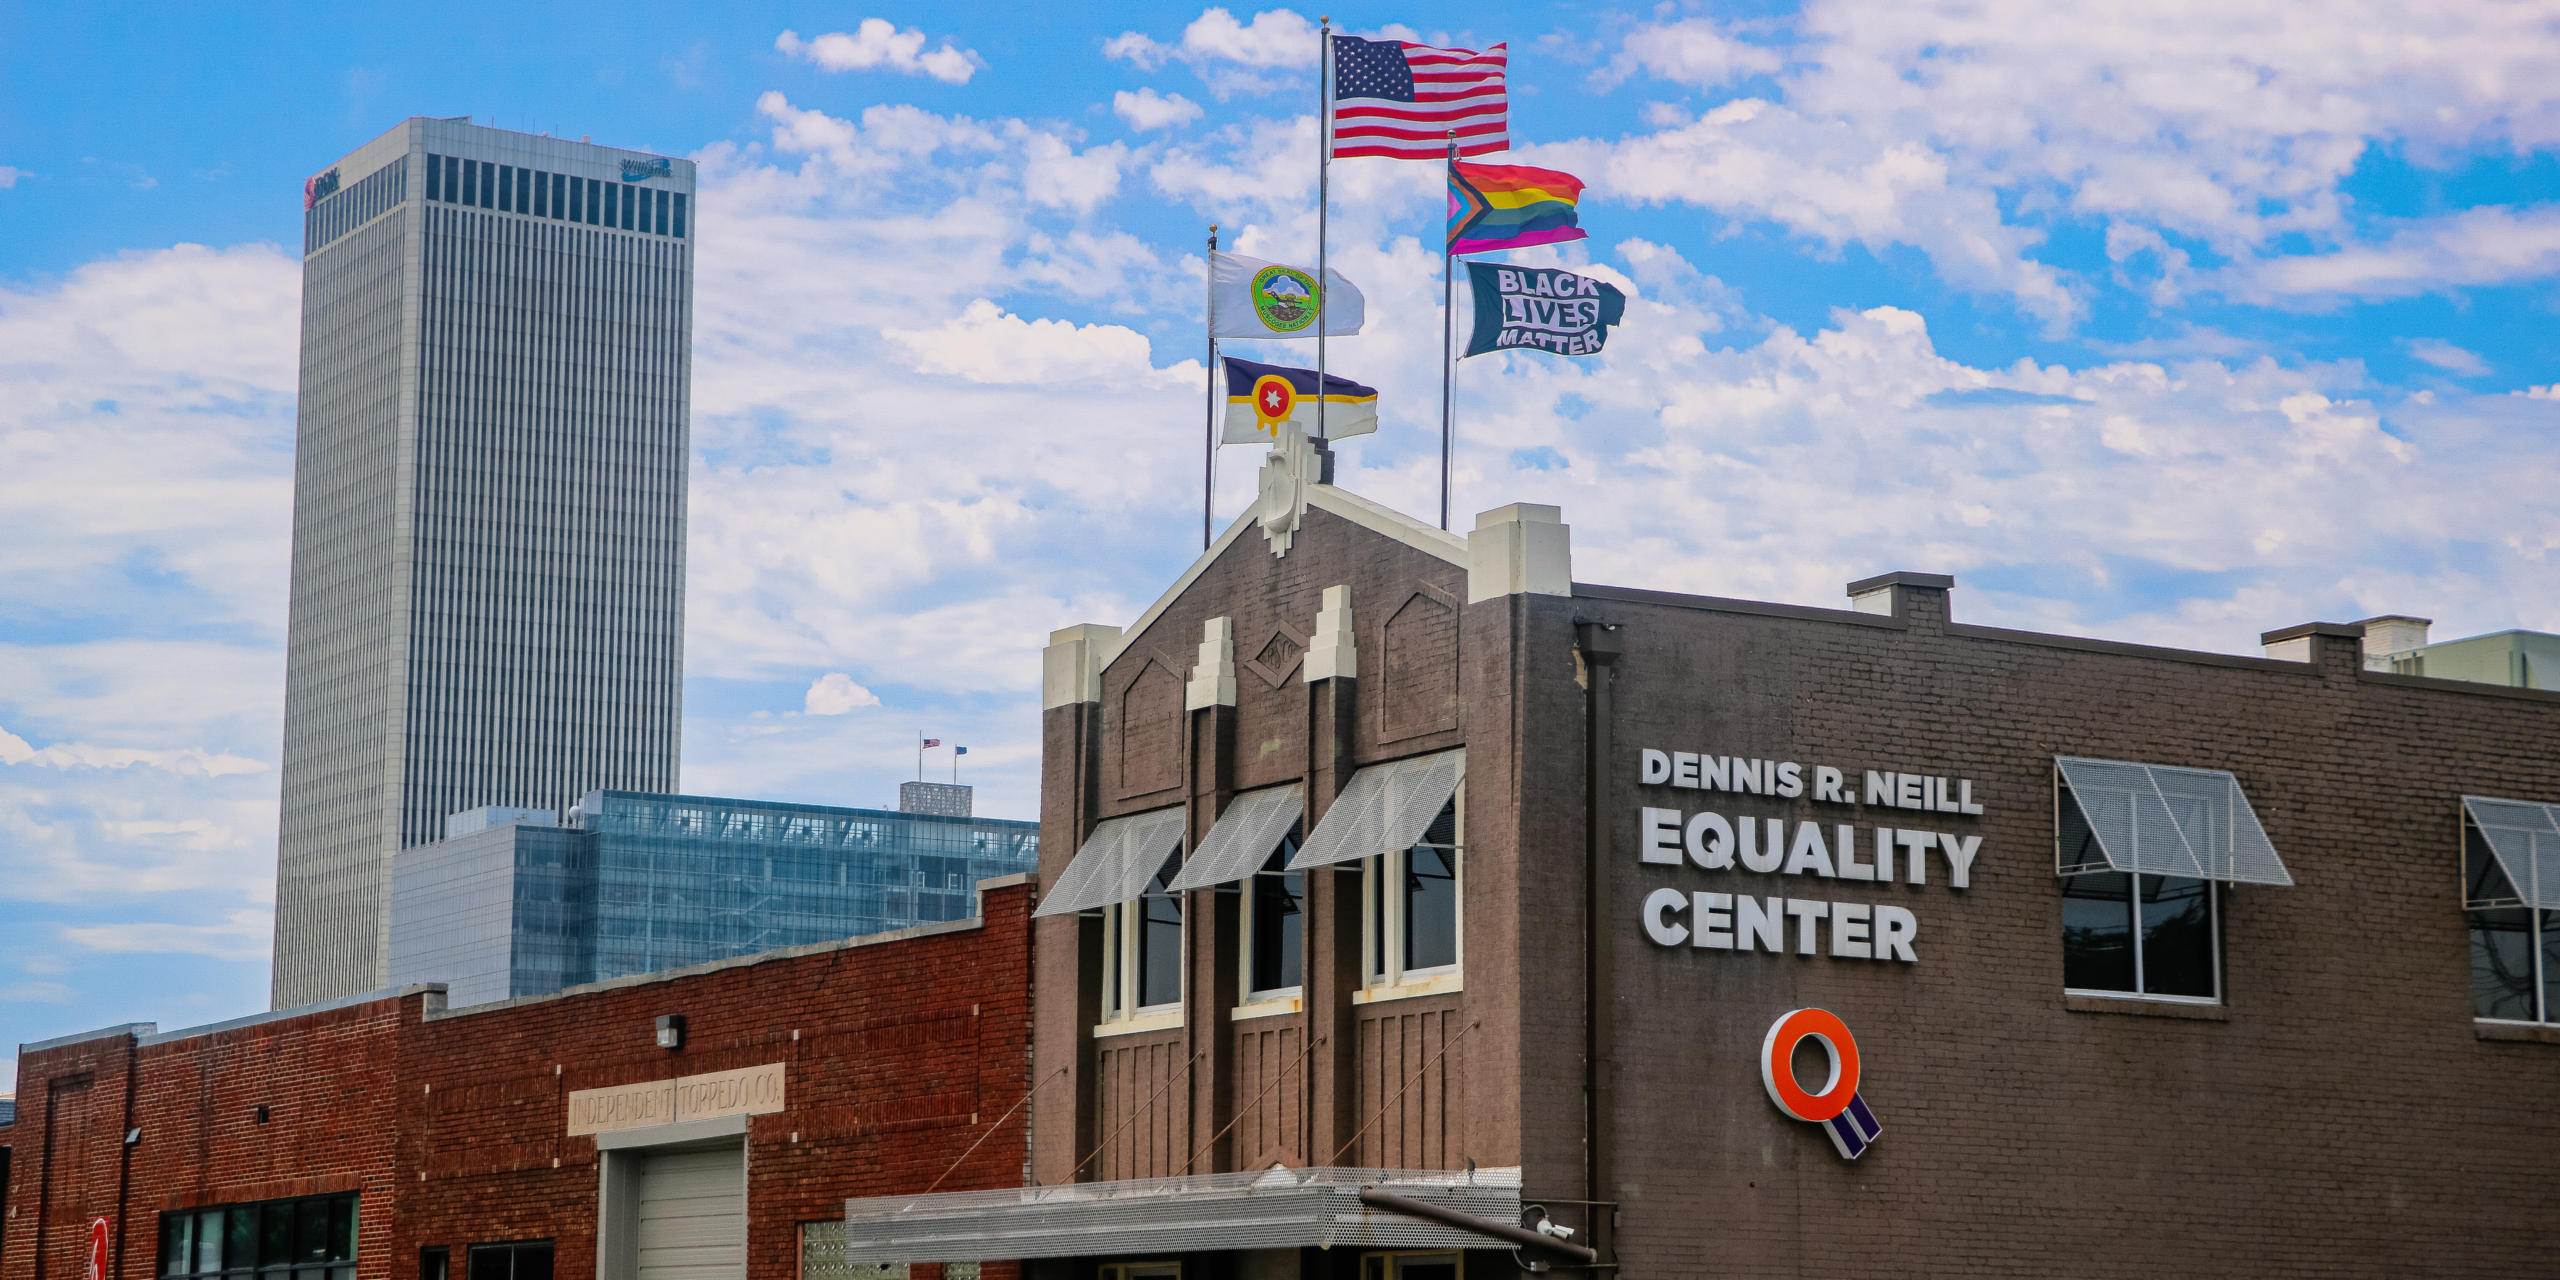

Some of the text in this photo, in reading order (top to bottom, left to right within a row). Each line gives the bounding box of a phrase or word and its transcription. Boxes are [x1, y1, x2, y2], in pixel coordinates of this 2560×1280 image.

[620, 159, 672, 178] Williams
[1259, 269, 1276, 283] GREAT
[1498, 270, 1600, 297] BLACK
[1260, 305, 1287, 329] MUSCOGEE
[1288, 314, 1309, 329] NATION
[1503, 299, 1596, 328] LIVES
[1497, 329, 1602, 355] MATTER
[1639, 748, 1984, 815] DENNIS R. NEILL
[1638, 806, 1983, 888] EQUALITY
[1640, 887, 1919, 962] CENTER
[573, 1087, 672, 1127] INDEPENDENT
[755, 1072, 781, 1105] CO.
